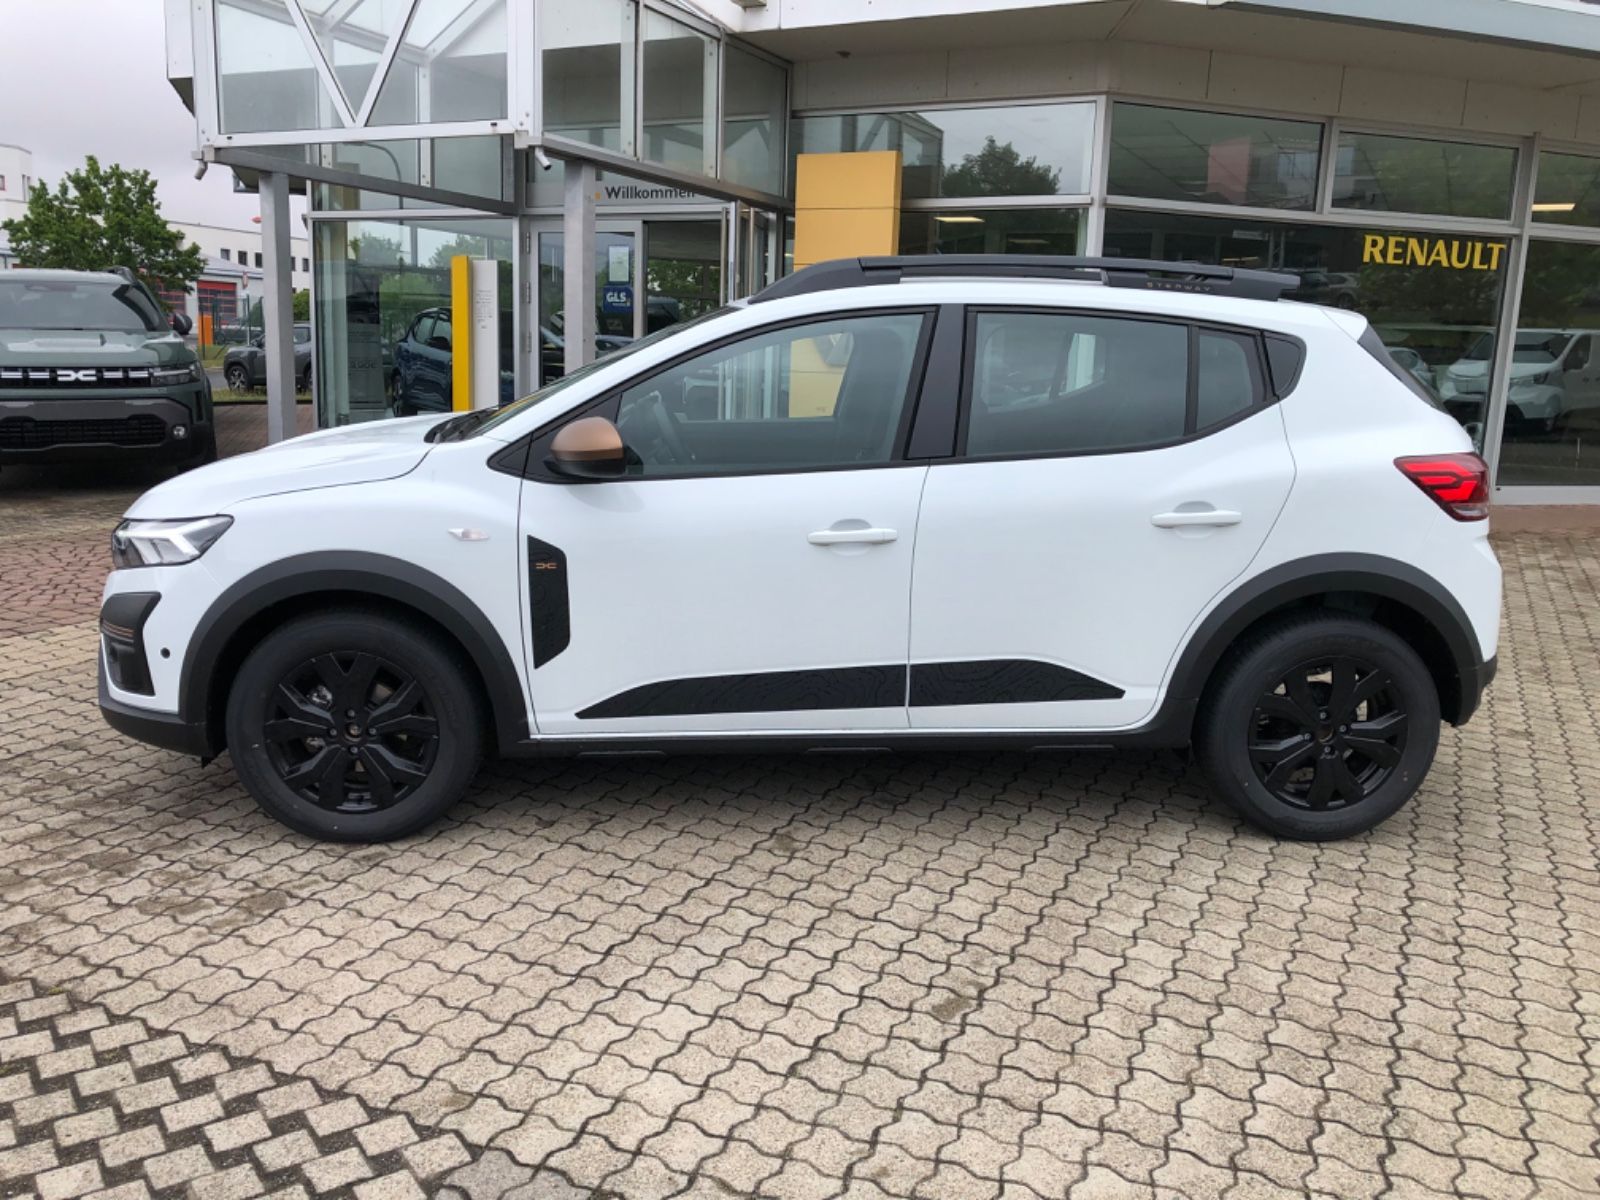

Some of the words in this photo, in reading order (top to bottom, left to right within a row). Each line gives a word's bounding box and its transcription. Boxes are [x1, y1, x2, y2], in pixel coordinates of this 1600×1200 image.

[605, 185, 695, 199] Willkommen
[1362, 233, 1507, 271] RENAULT
[606, 291, 627, 303] GLS
